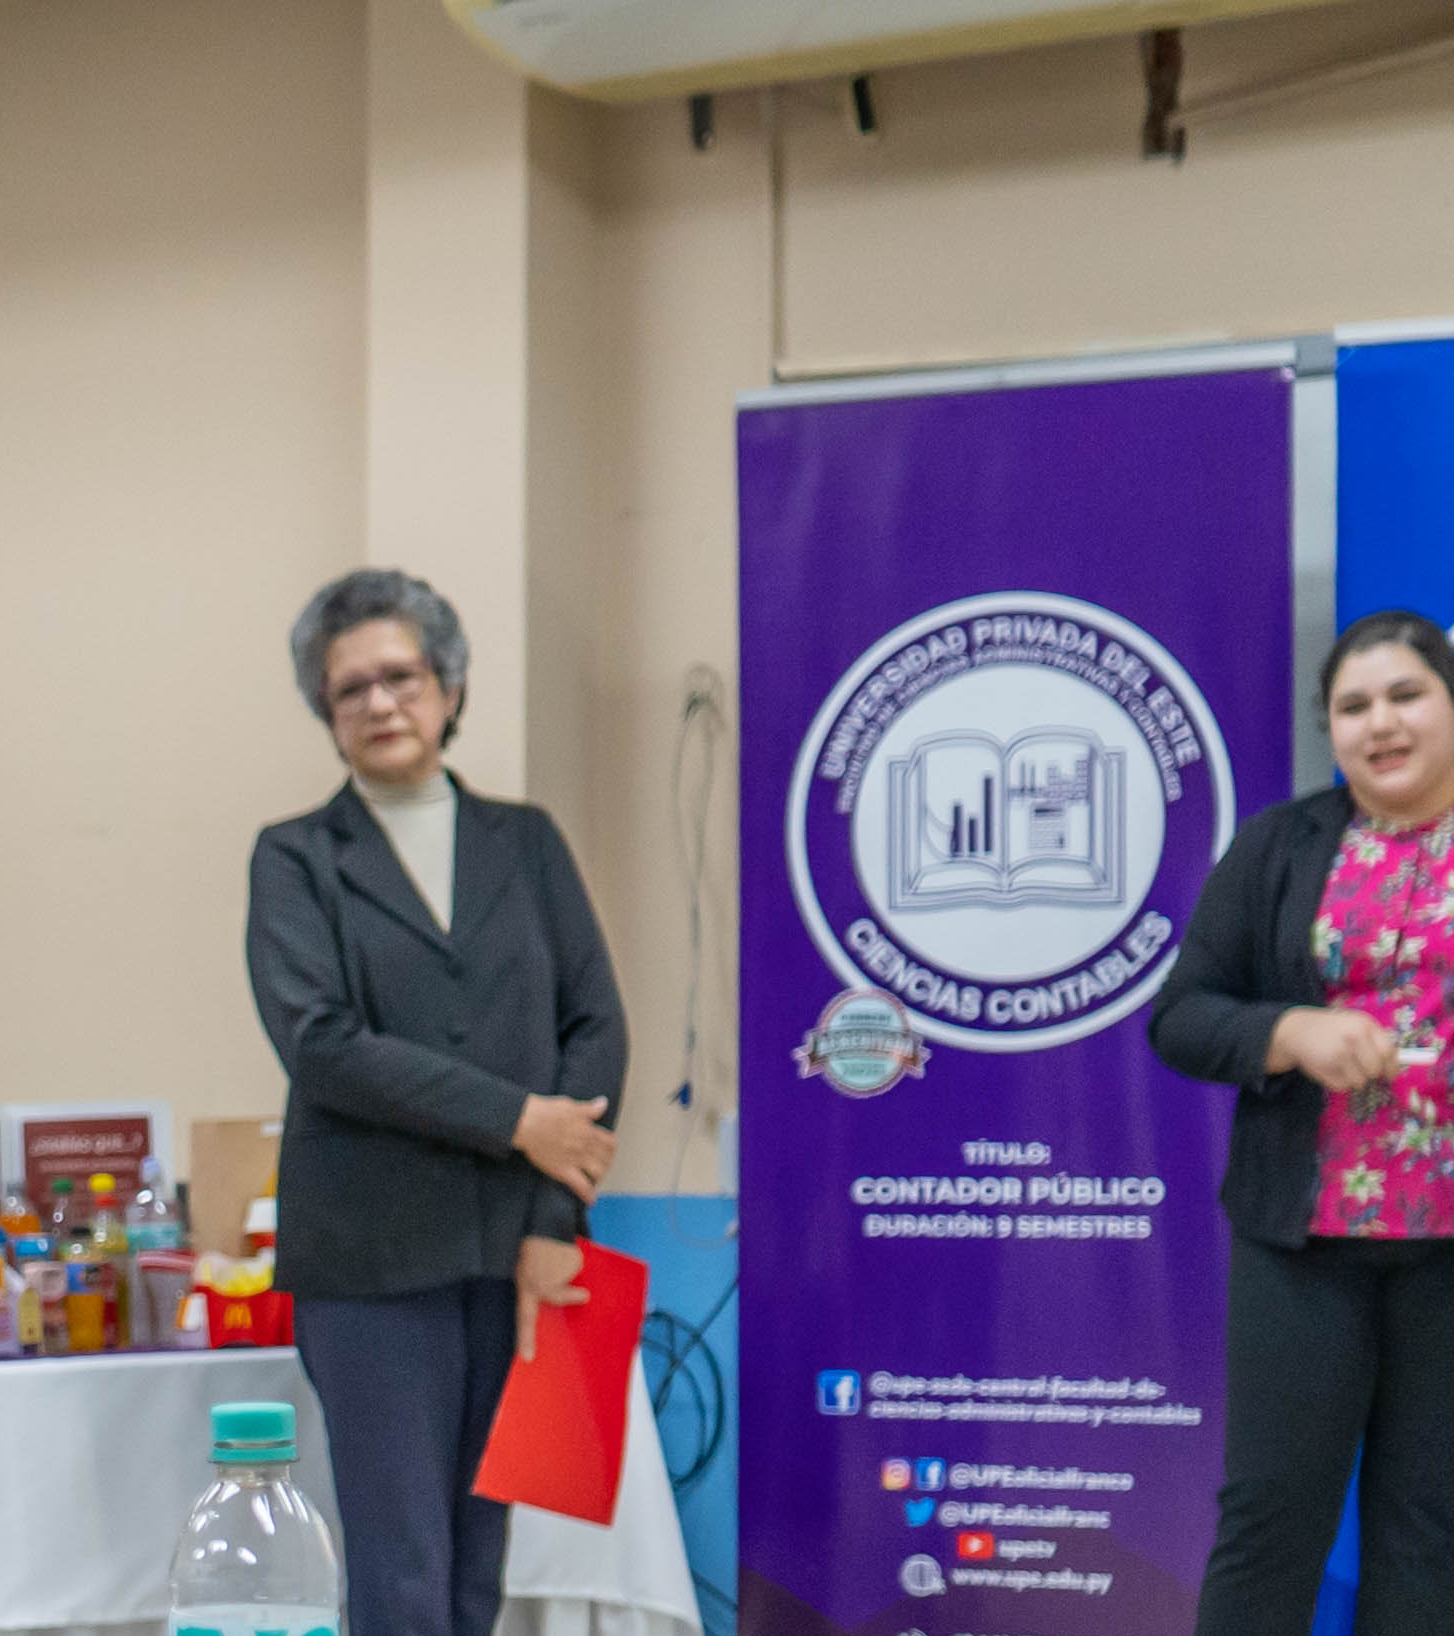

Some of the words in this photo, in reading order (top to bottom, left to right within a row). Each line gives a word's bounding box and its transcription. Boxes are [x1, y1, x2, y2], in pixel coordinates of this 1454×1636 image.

[820, 626, 969, 779] UNIVERSIDAD
[971, 614, 1098, 658] PRIVADA
[1099, 641, 1152, 690] DEL
[1147, 686, 1202, 768] ESTE
[845, 918, 982, 1022] CIENCIAS
[986, 910, 1173, 1024] CONTABLES
[962, 1138, 1051, 1165] TÍTULO:
[851, 1176, 1023, 1205] CONTADOR
[1026, 1171, 1166, 1206] PÚBLICO
[862, 1210, 993, 1238] DURACIÓN:
[995, 1215, 1012, 1238] 9
[1015, 1214, 1152, 1239] SEMESTRES
[949, 1568, 1114, 1595] www.upe.edu.py
